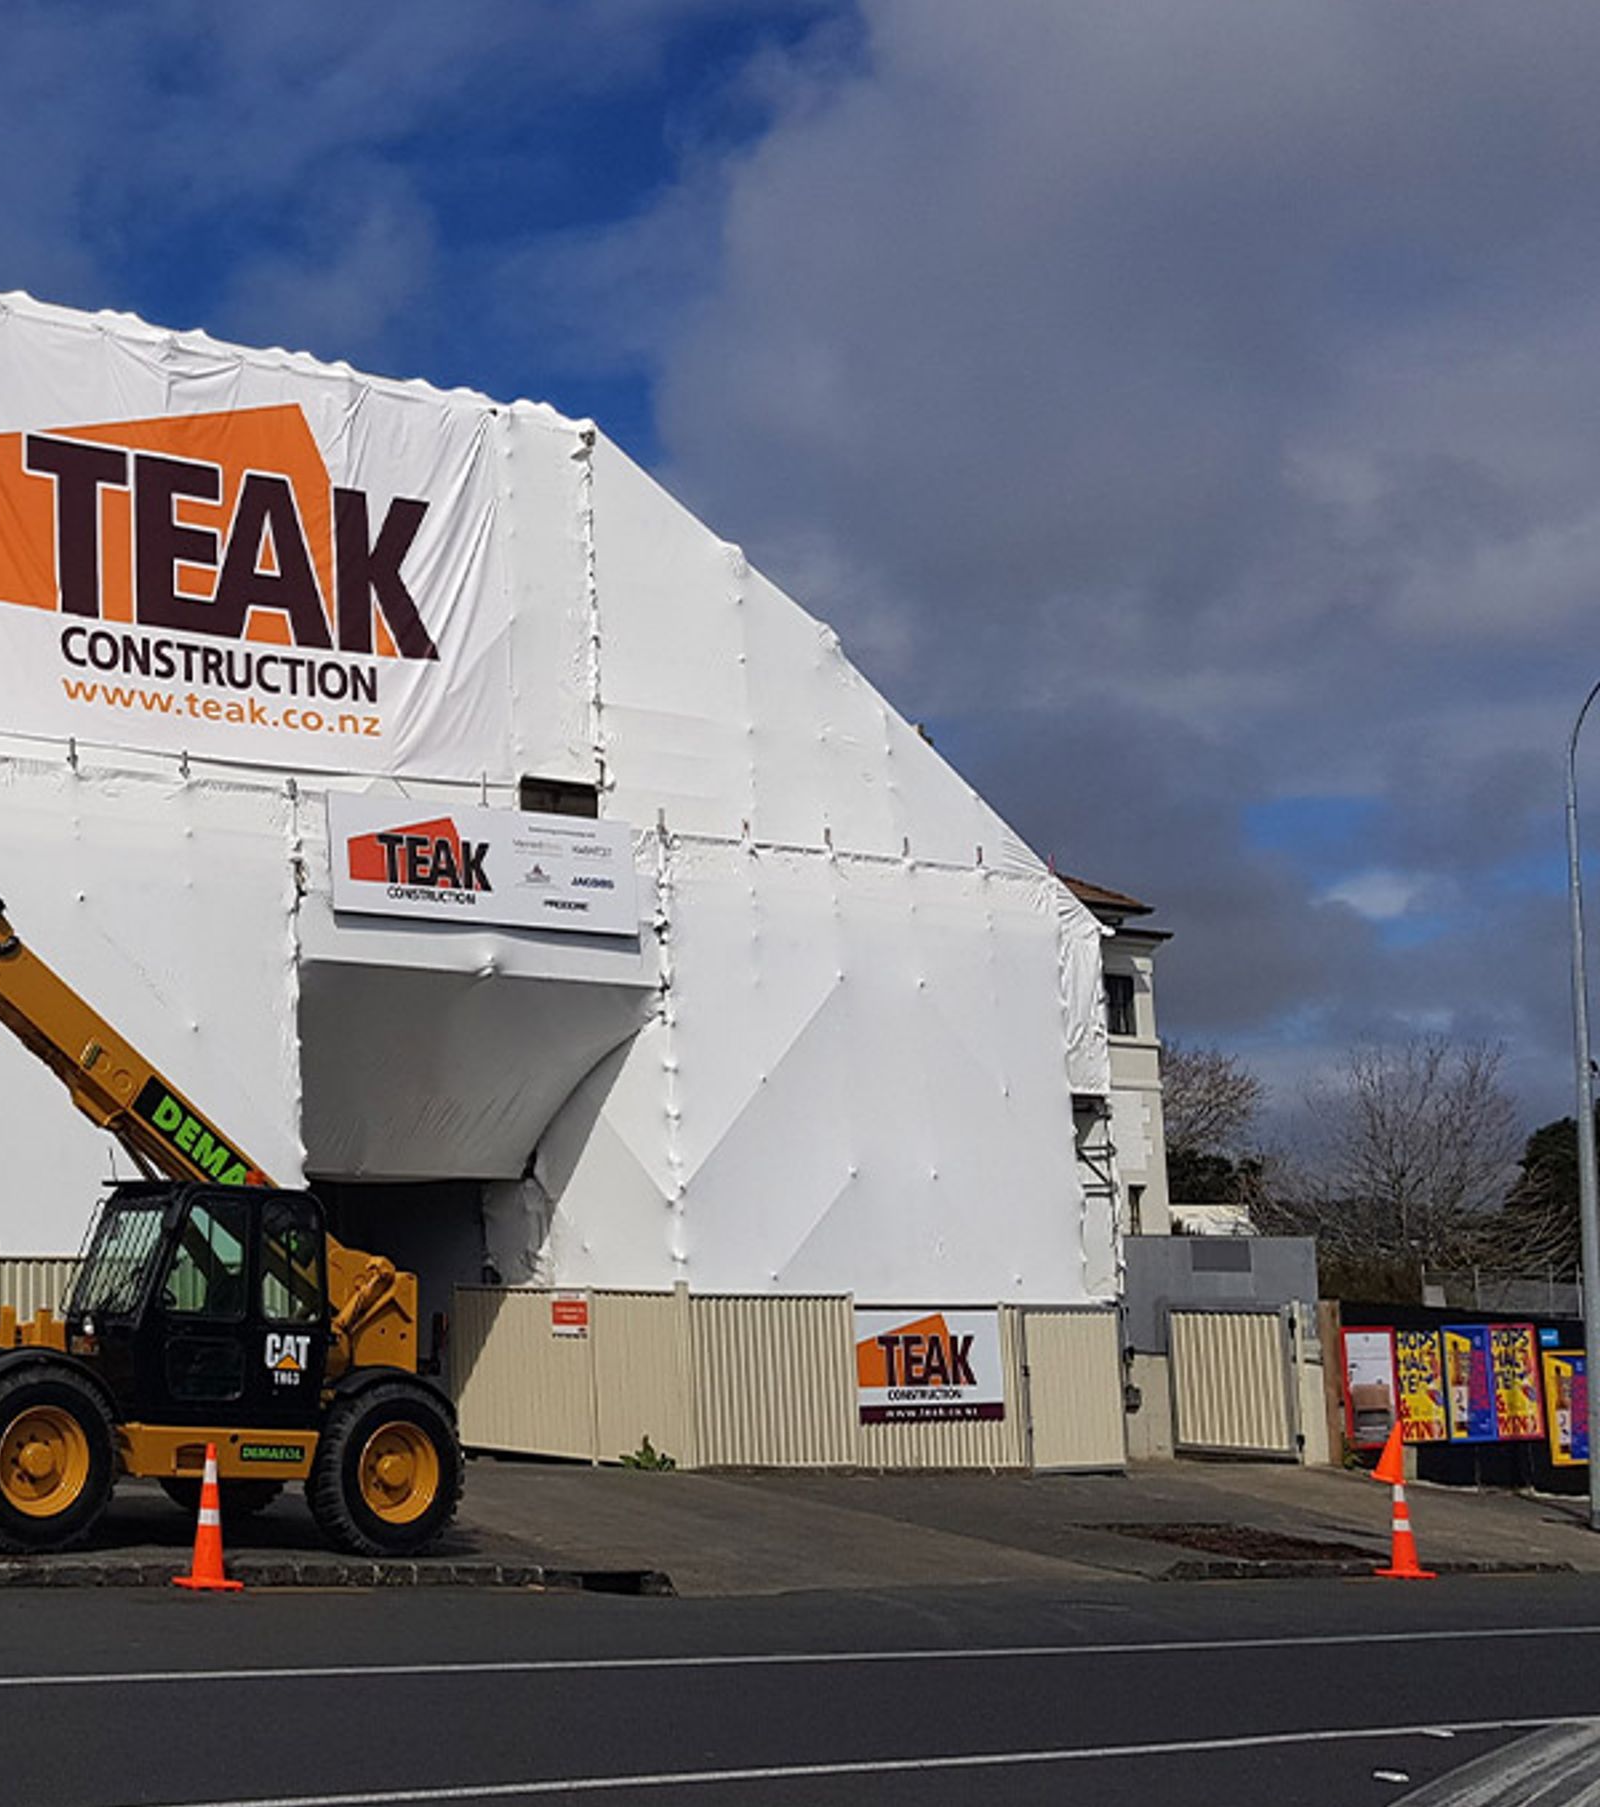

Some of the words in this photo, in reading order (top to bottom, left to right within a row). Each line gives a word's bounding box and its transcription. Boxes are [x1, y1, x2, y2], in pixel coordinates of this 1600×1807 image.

[25, 432, 440, 662] TEAK
[60, 625, 378, 703] CONSTRUCTION
[61, 677, 382, 737] www.teak.co.nz
[376, 832, 493, 892] TEAK
[387, 885, 476, 905] CONSTRUCTION
[151, 1094, 248, 1186] DEMA
[264, 1333, 311, 1370] CAT
[876, 1335, 978, 1387] TEAK
[887, 1388, 963, 1402] CONSTRUCTION
